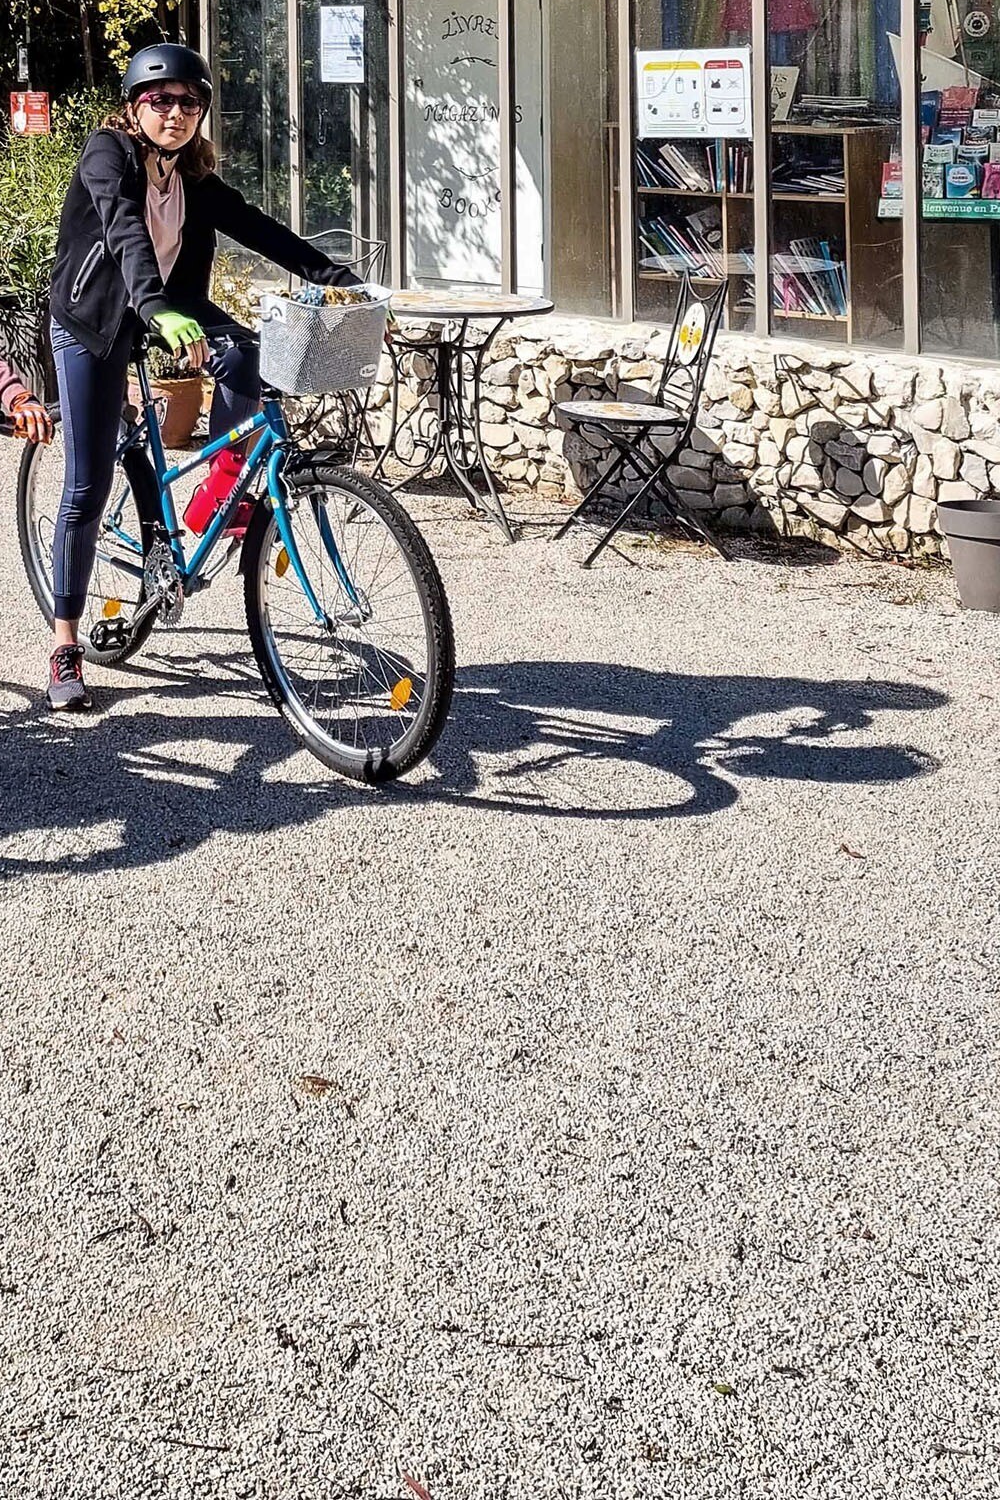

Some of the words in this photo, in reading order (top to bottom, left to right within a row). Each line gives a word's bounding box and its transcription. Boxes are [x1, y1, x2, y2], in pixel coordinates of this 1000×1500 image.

[442, 12, 500, 40] LIVRE
[424, 102, 523, 123] MAGAZINS
[974, 205, 987, 213] en
